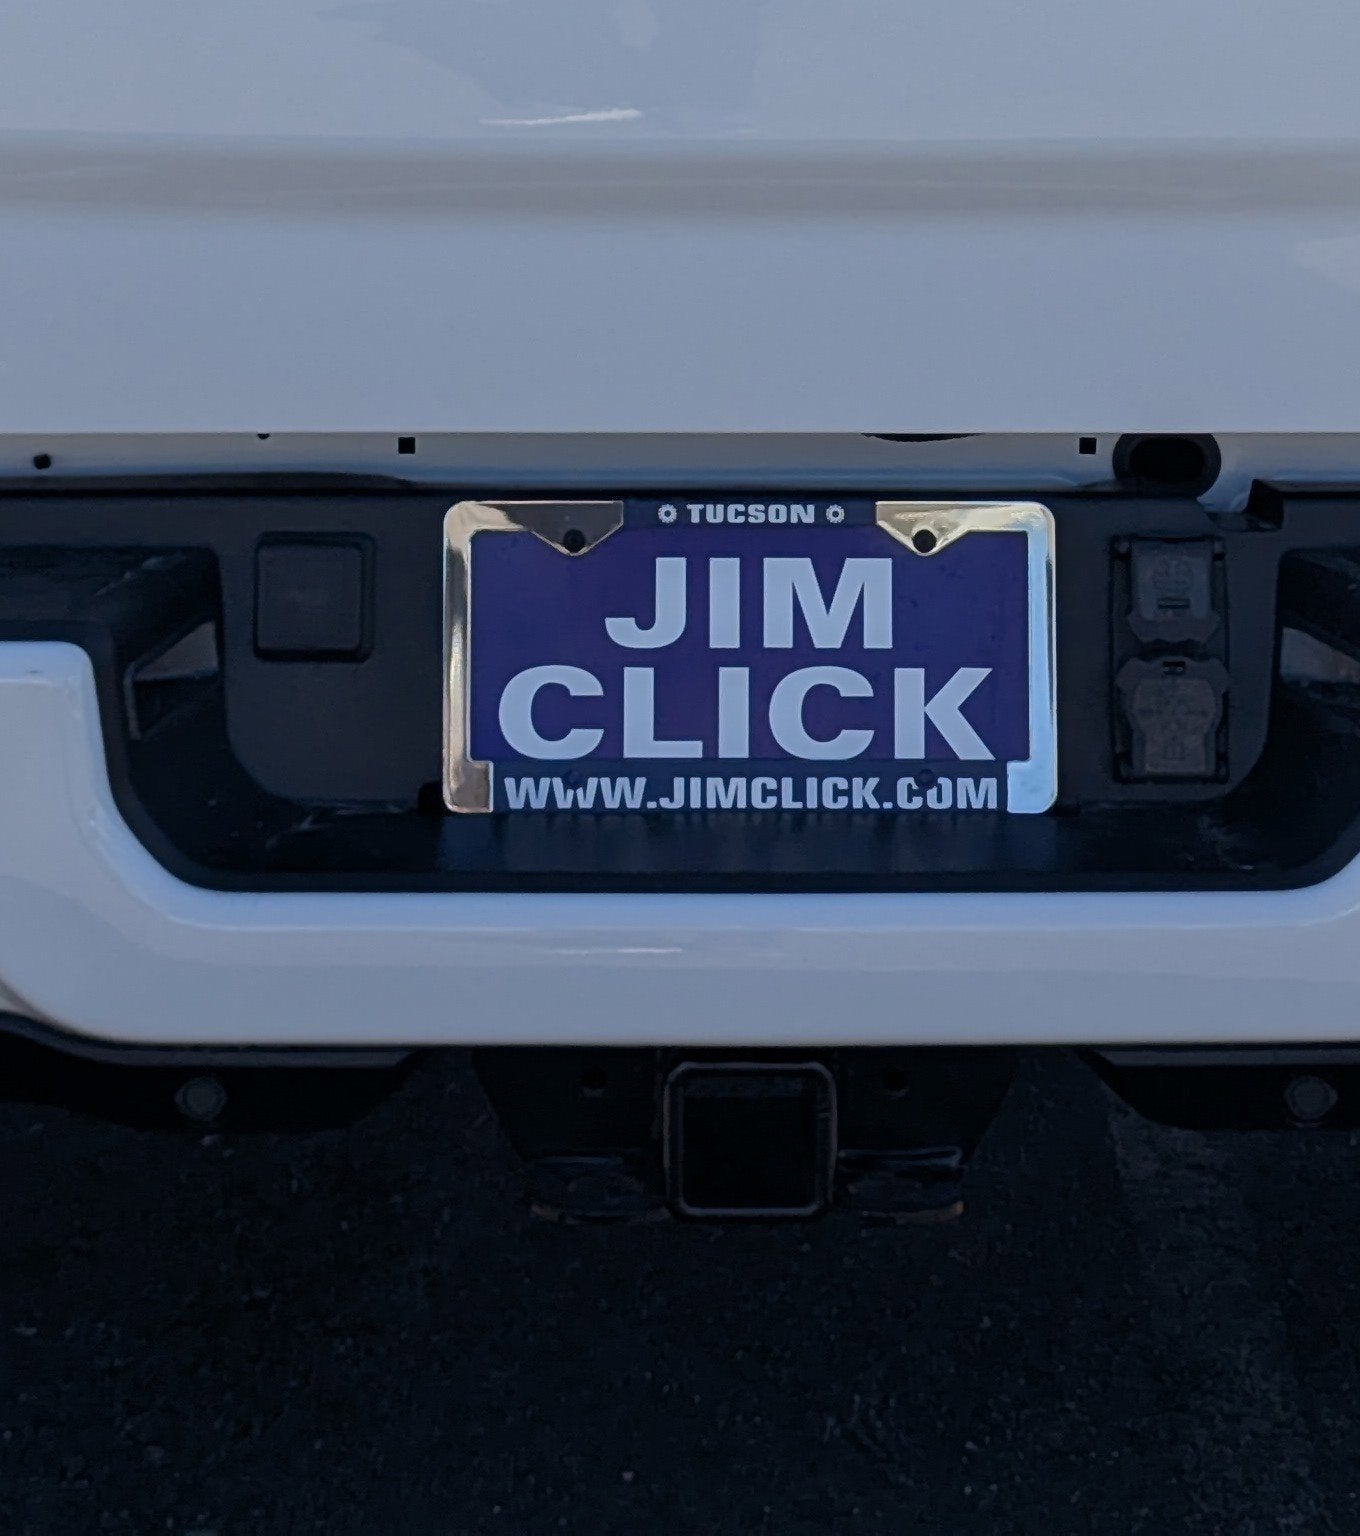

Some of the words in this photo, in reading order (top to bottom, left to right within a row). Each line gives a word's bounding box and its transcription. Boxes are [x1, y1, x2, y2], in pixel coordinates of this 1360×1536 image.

[687, 503, 815, 524] TUCSON
[605, 557, 893, 649] JIM
[498, 664, 996, 761] CLICK
[504, 776, 998, 810] WWW.JIMCLICK.COM
